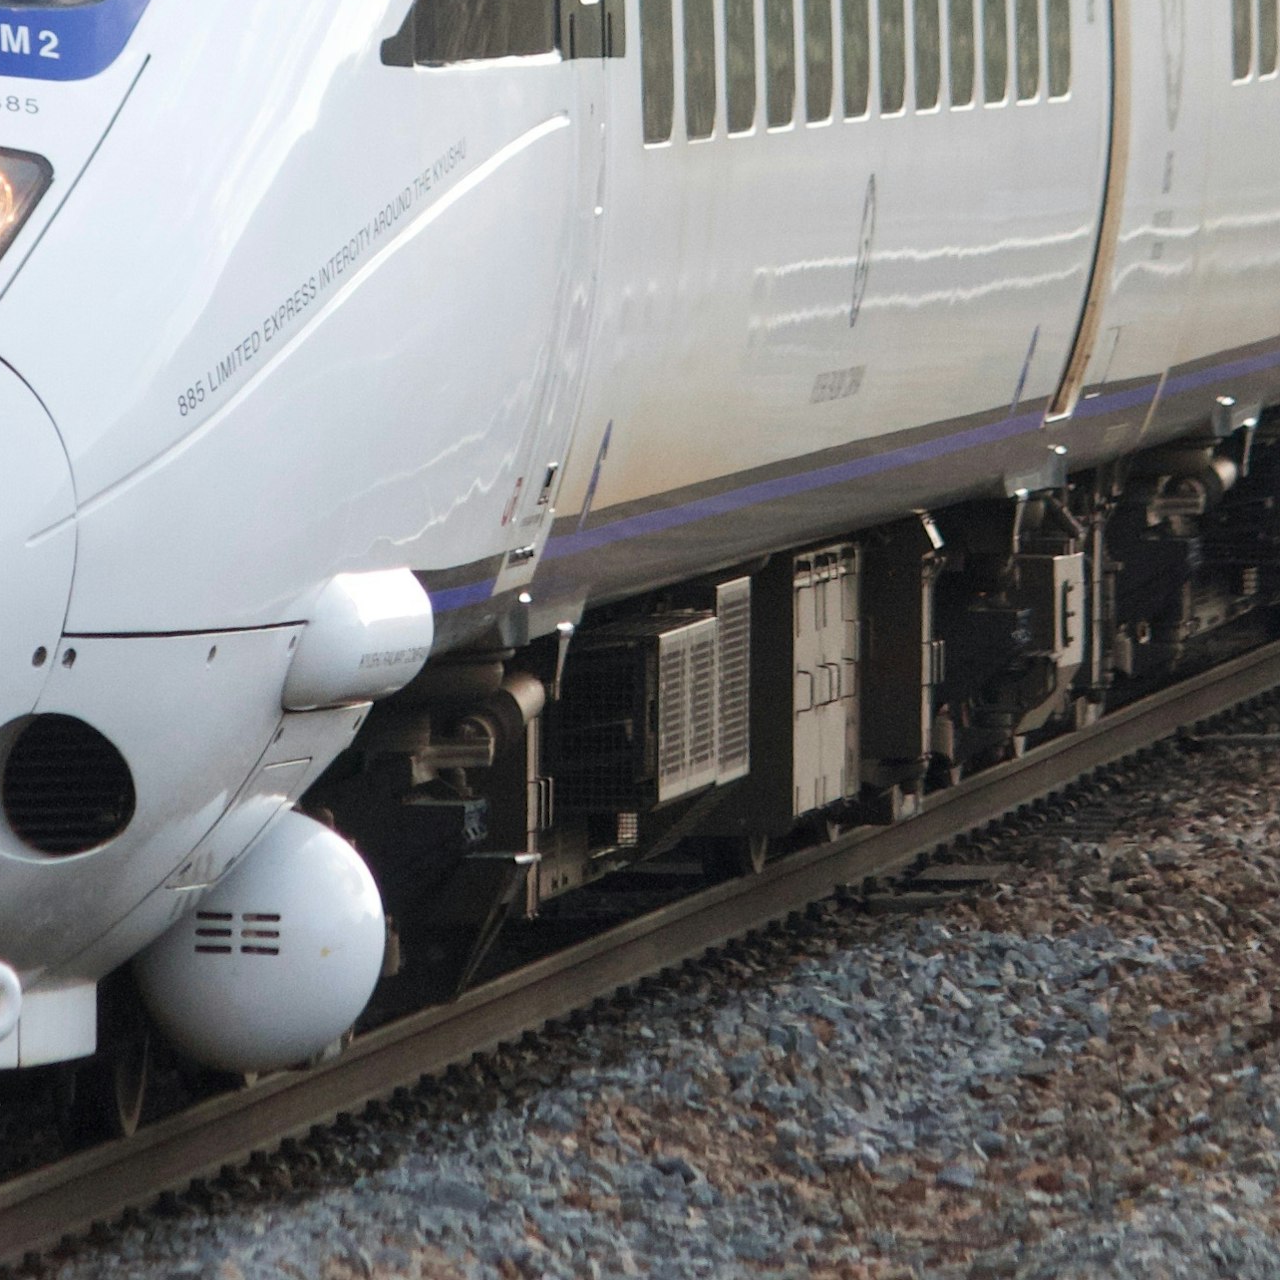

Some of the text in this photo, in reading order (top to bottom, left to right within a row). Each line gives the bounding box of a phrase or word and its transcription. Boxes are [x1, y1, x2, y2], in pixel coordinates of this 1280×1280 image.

[177, 136, 467, 417] 885 LIMITED EXPRESS INTERCITY AROUND THE KYUSHU
